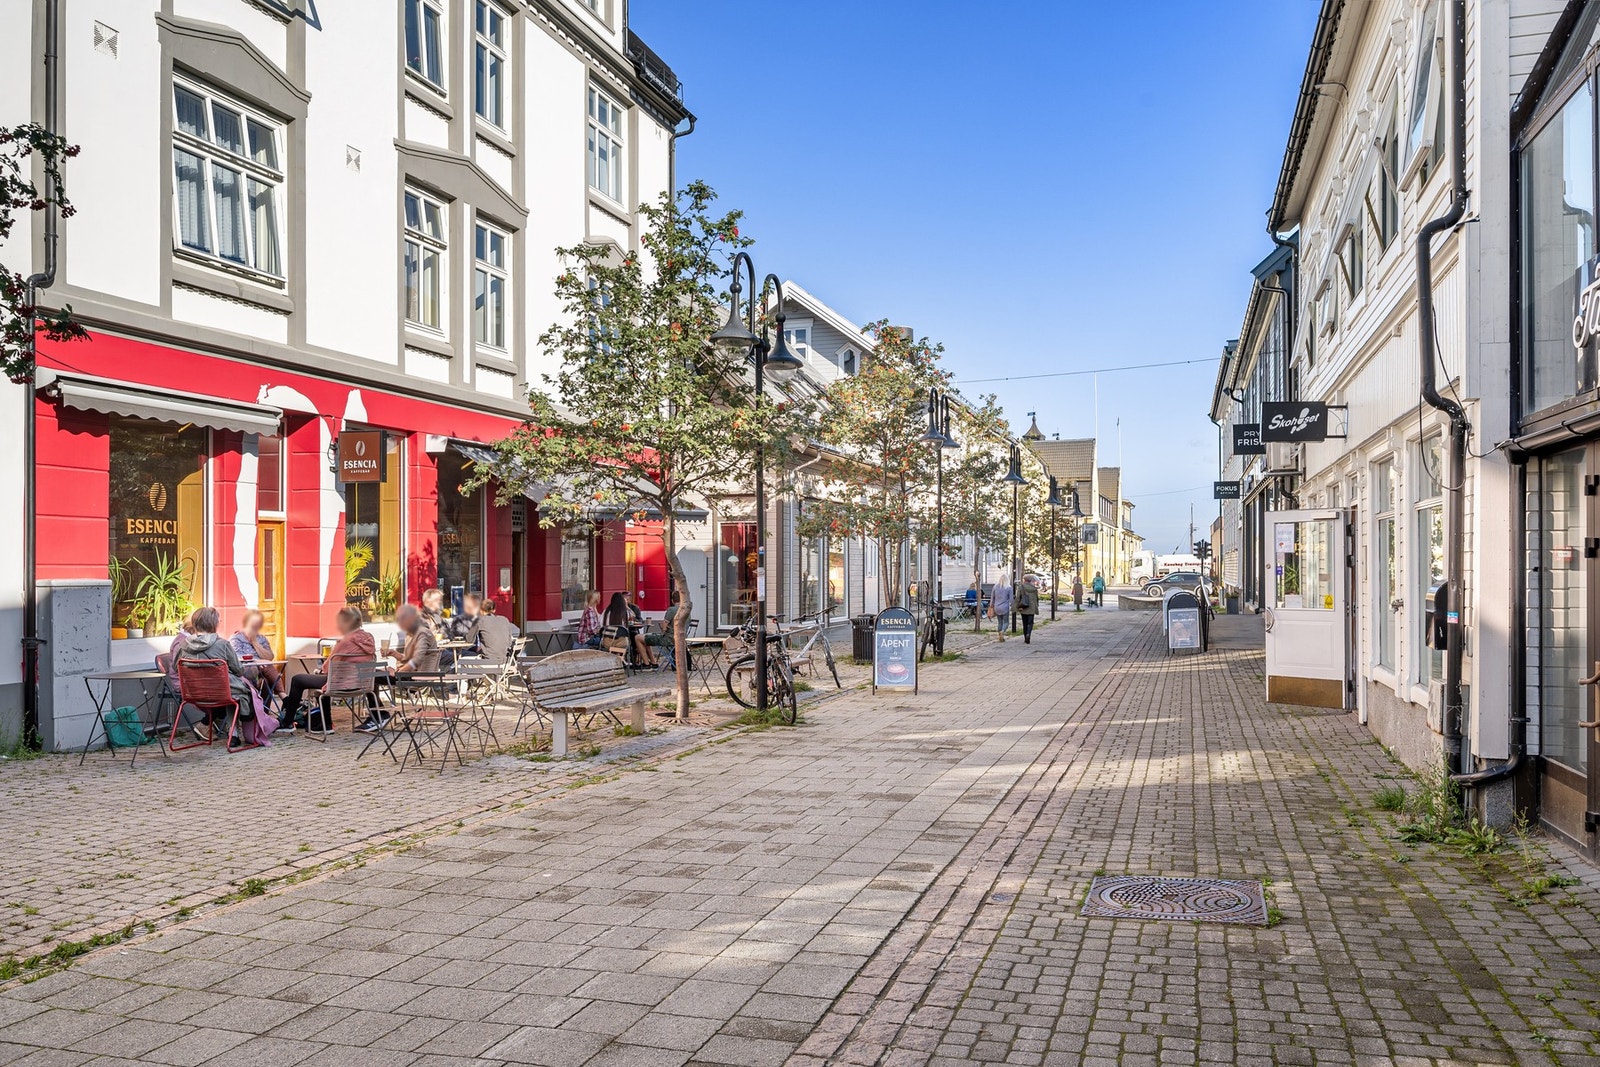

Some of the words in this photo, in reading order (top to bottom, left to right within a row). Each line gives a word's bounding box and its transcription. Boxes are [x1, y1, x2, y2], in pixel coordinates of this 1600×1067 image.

[343, 459, 377, 470] ESENCIA
[126, 518, 178, 535] ESENCI
[880, 638, 910, 648] ÅPENT
